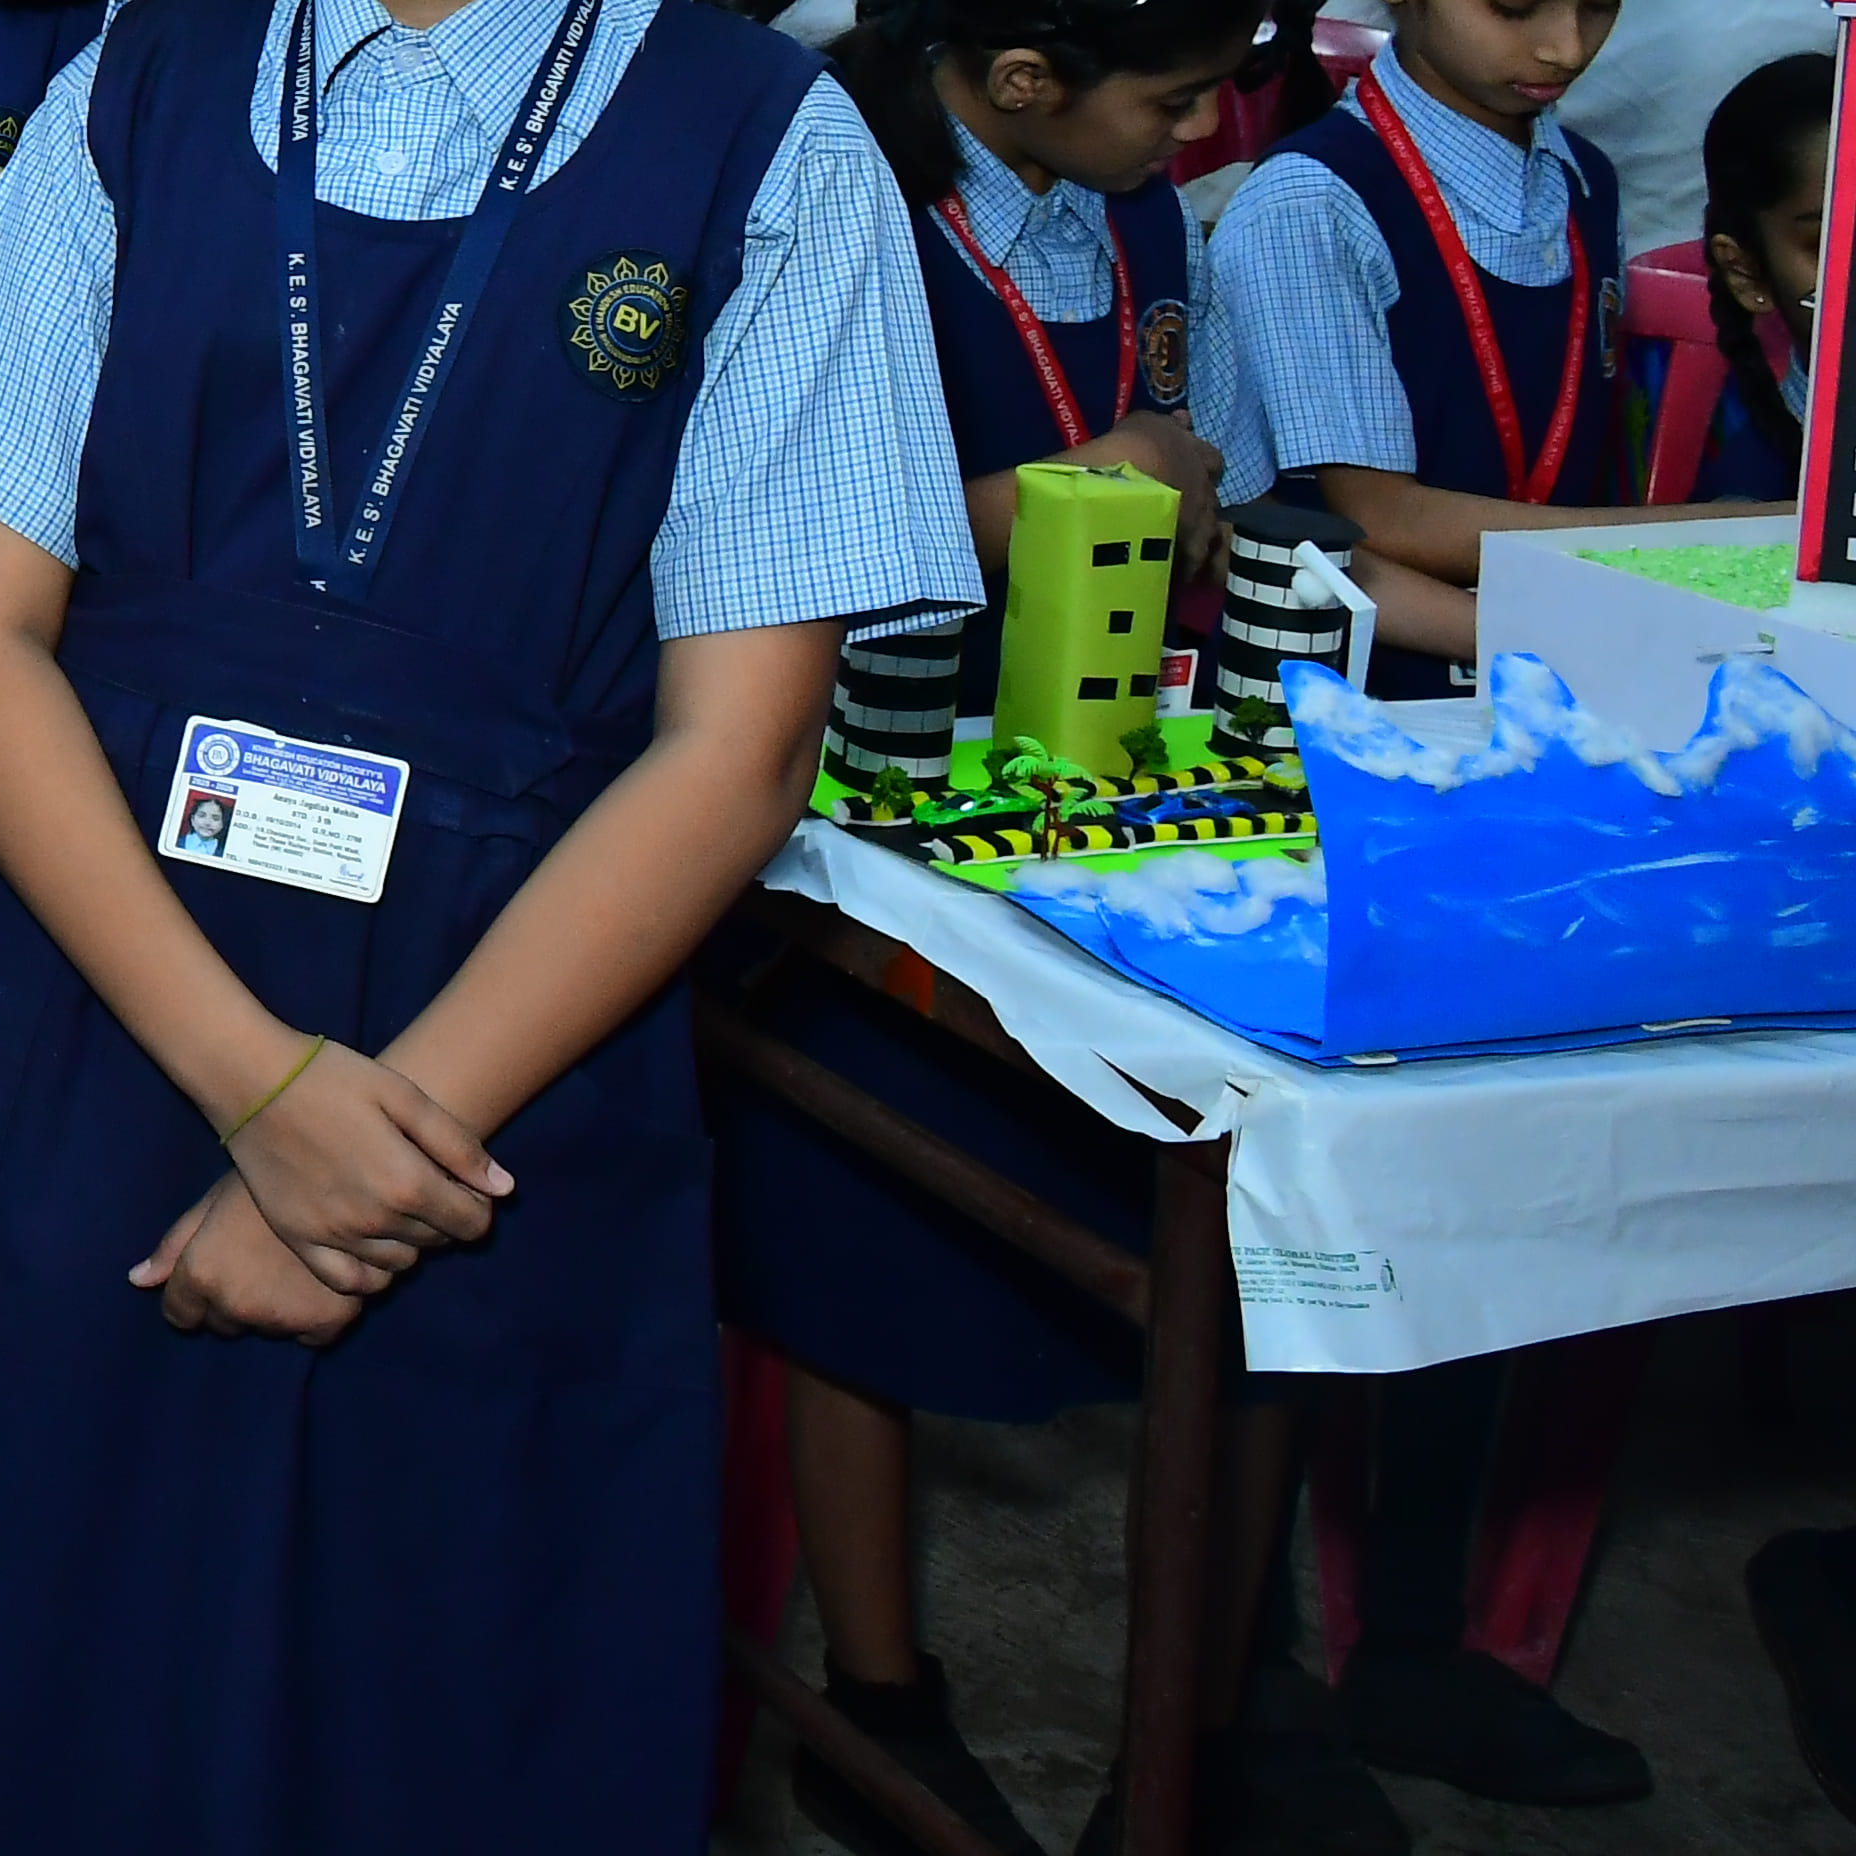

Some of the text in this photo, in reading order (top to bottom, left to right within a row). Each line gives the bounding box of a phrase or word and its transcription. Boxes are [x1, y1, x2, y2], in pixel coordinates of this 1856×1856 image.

[613, 304, 660, 339] BV
[291, 322, 322, 528] BHAGAVATI VIDYALAYA
[372, 302, 463, 497] BHAGAVATI VIDYALAYA
[243, 752, 386, 794] BHAGAVATI VIDYALAYA
